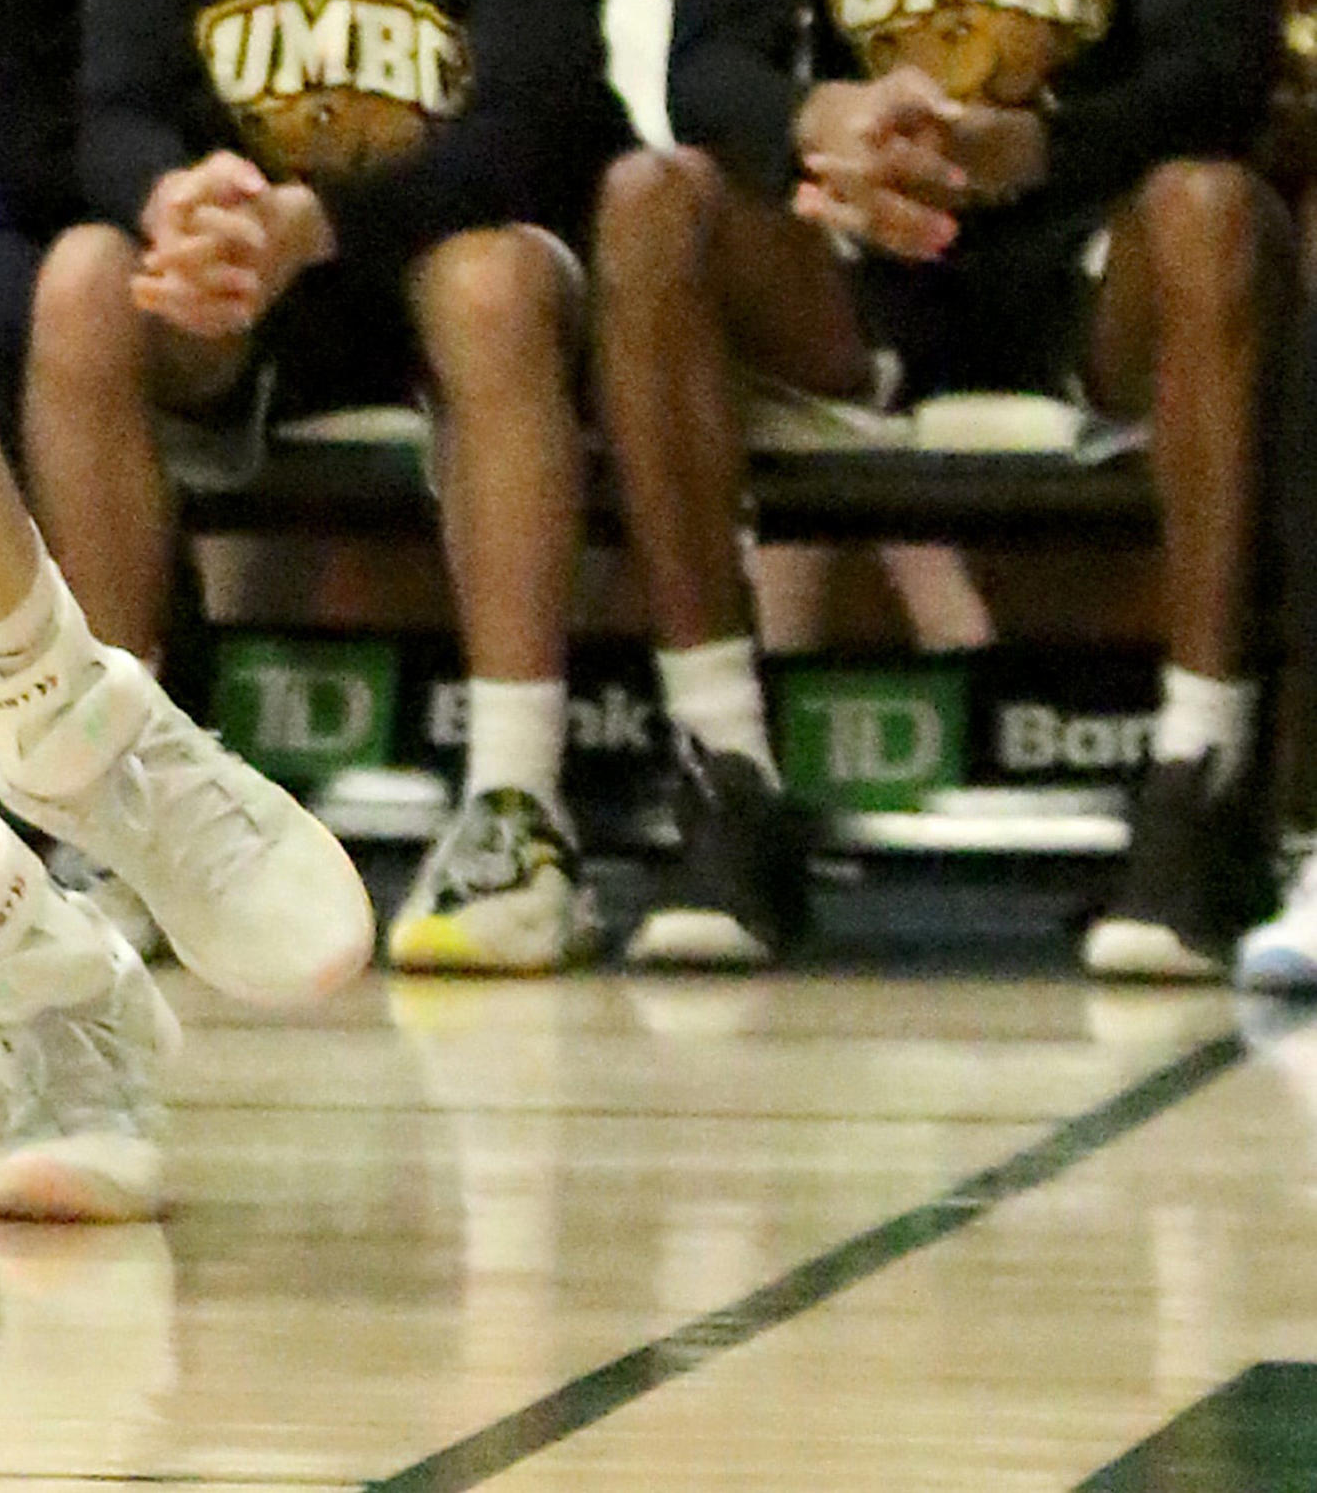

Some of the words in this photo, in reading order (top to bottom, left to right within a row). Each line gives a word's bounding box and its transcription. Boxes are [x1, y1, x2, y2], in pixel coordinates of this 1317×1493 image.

[235, 664, 375, 754] TD
[799, 700, 944, 782] TD
[998, 702, 1165, 770] Ban
